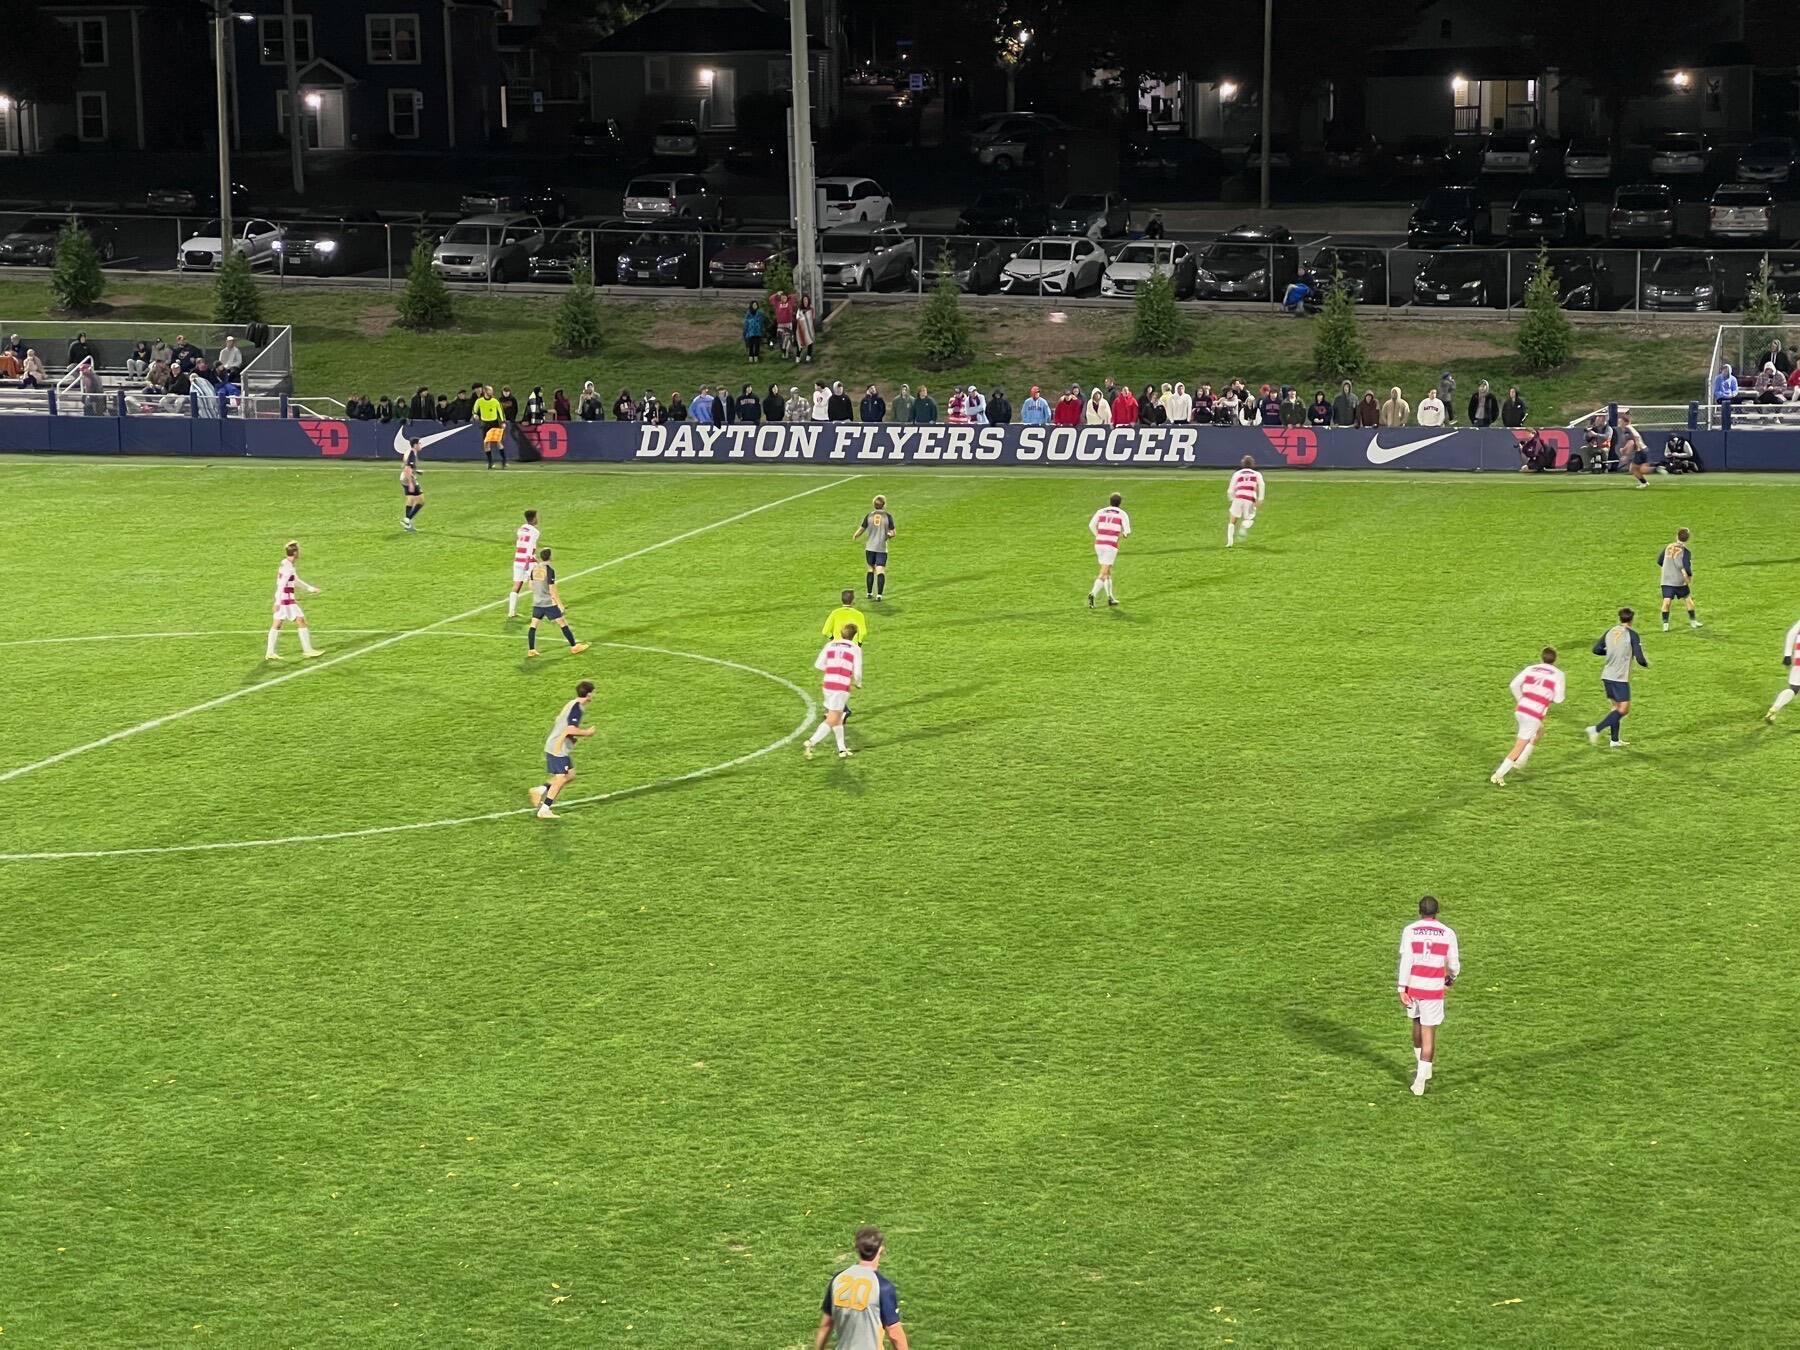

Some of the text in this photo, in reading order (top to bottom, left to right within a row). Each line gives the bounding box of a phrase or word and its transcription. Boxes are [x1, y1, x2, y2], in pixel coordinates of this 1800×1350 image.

[314, 421, 349, 455] D
[537, 423, 568, 458] D
[635, 424, 1198, 462] DAYTON FLYERS SOCCER
[1281, 428, 1318, 464] D
[873, 514, 882, 526] 8
[834, 1275, 873, 1312] 20
